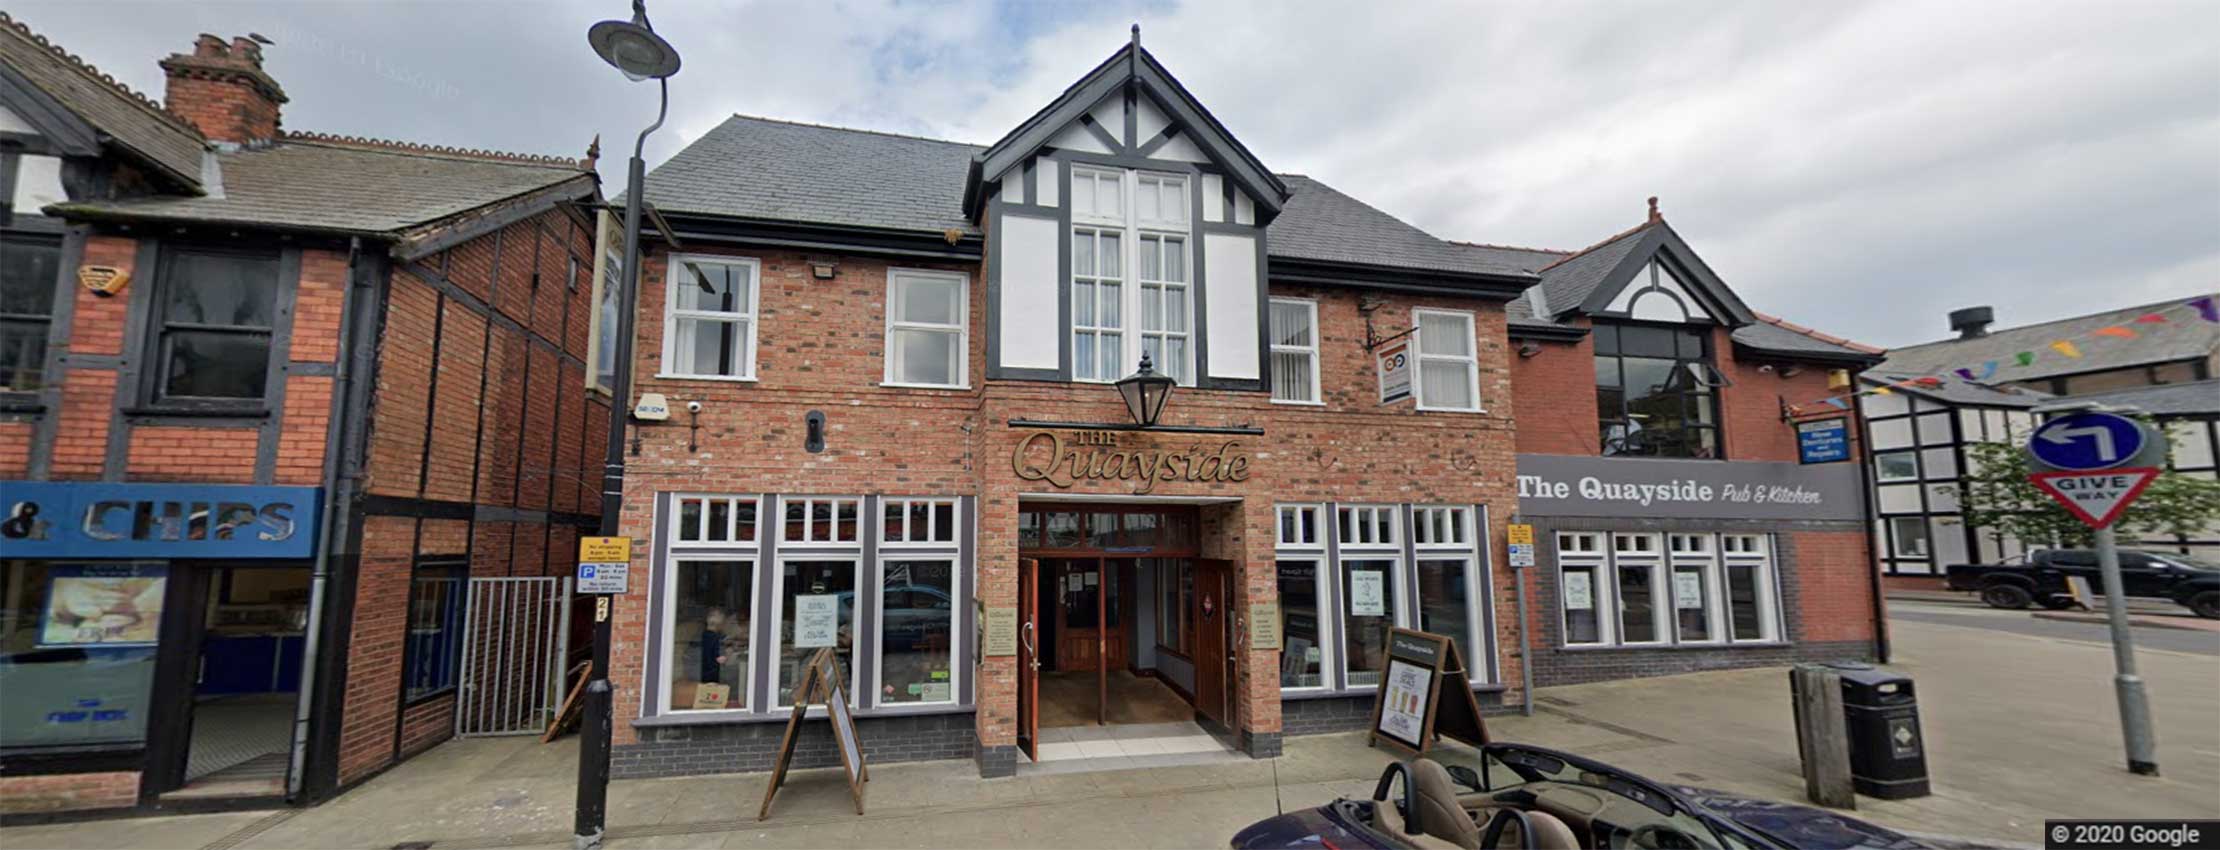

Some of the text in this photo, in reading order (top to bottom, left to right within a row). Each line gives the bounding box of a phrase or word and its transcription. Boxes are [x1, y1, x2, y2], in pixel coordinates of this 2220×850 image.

[1073, 431, 1117, 447] THE
[1012, 431, 1250, 495] Quayside
[1517, 474, 1823, 506] The Quayside Pub & Kitchen
[2057, 476, 2128, 490] GIVE
[2075, 491, 2119, 500] WAY
[1, 500, 295, 541] & CHIPS
[583, 567, 593, 577] P
